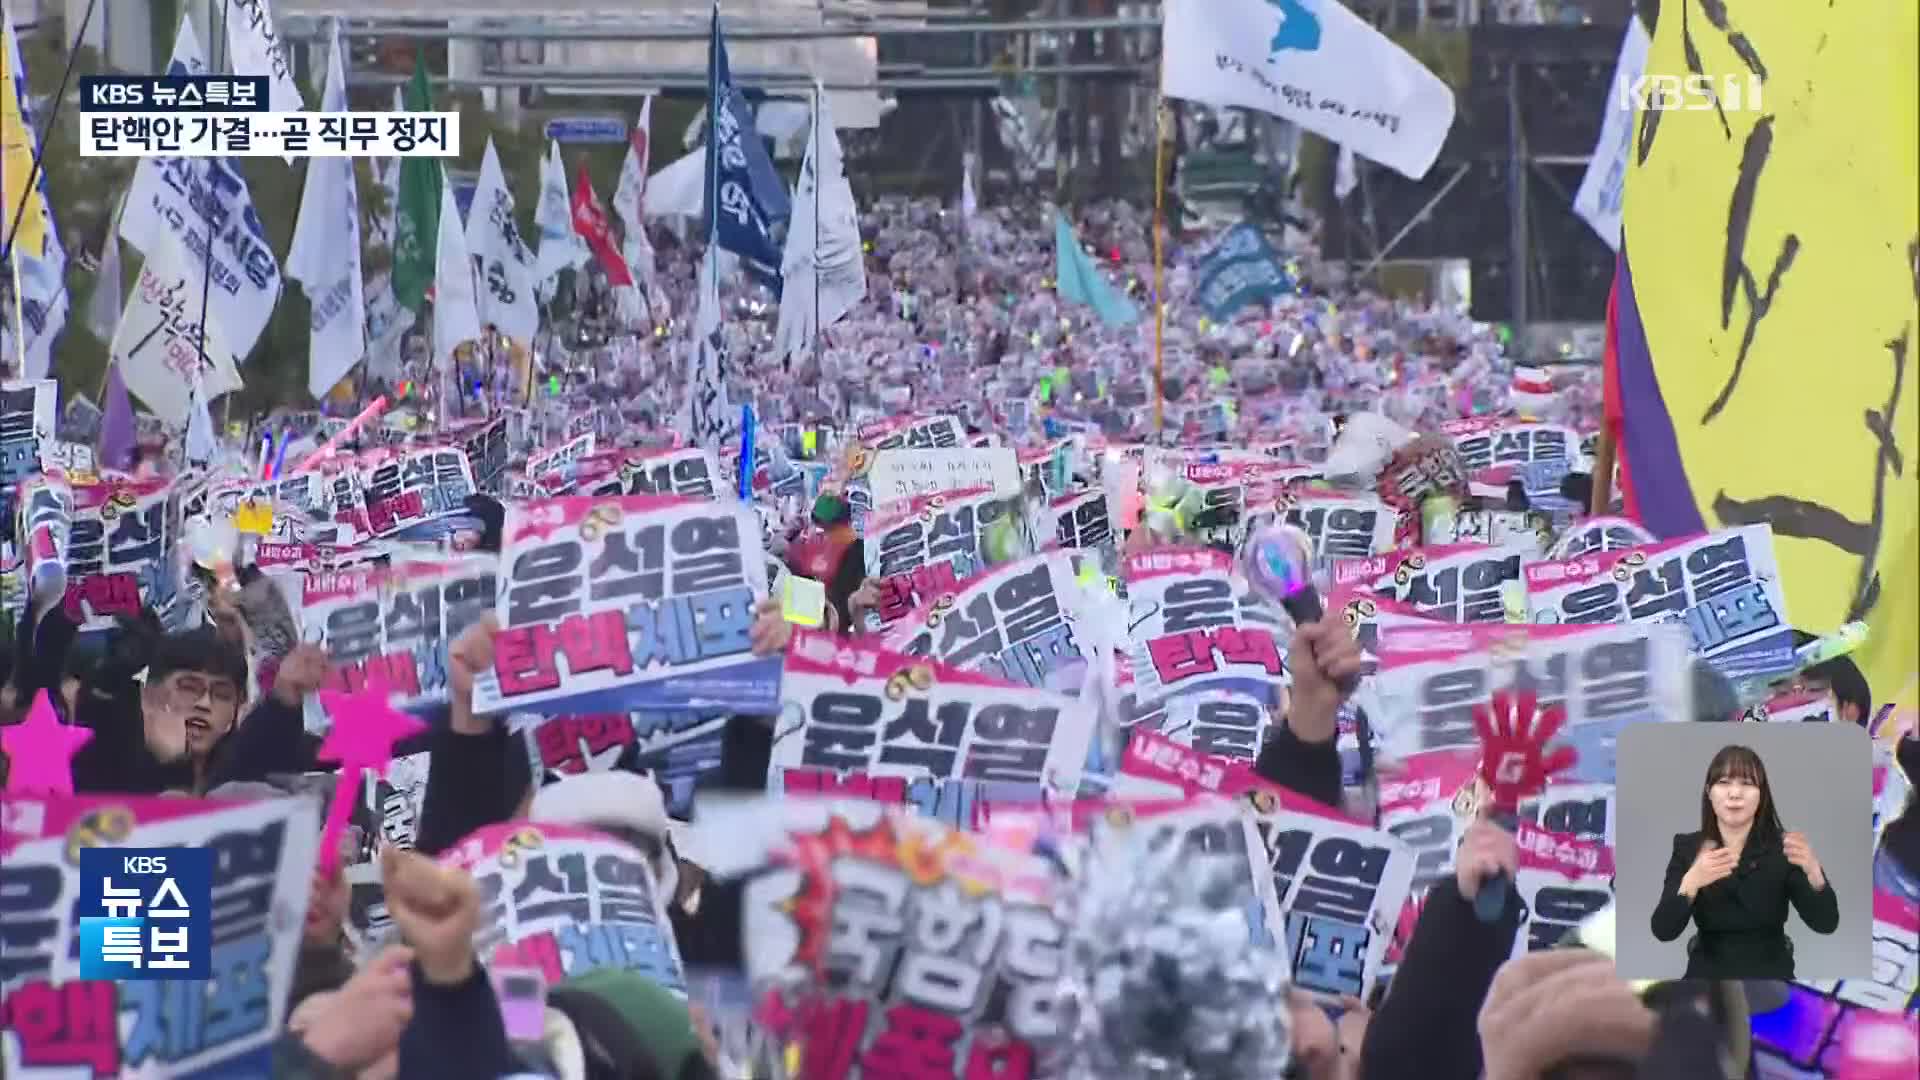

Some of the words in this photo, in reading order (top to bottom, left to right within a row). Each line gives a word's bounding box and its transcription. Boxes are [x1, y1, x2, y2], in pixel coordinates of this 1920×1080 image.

[370, 452, 464, 498] 윤석열
[1457, 431, 1566, 469] 윤석열
[508, 515, 746, 628] 윤석열
[492, 608, 633, 698] 탄핵
[629, 585, 757, 668] 체포
[1146, 626, 1283, 685] 탄핵
[801, 691, 1061, 784] 윤석열
